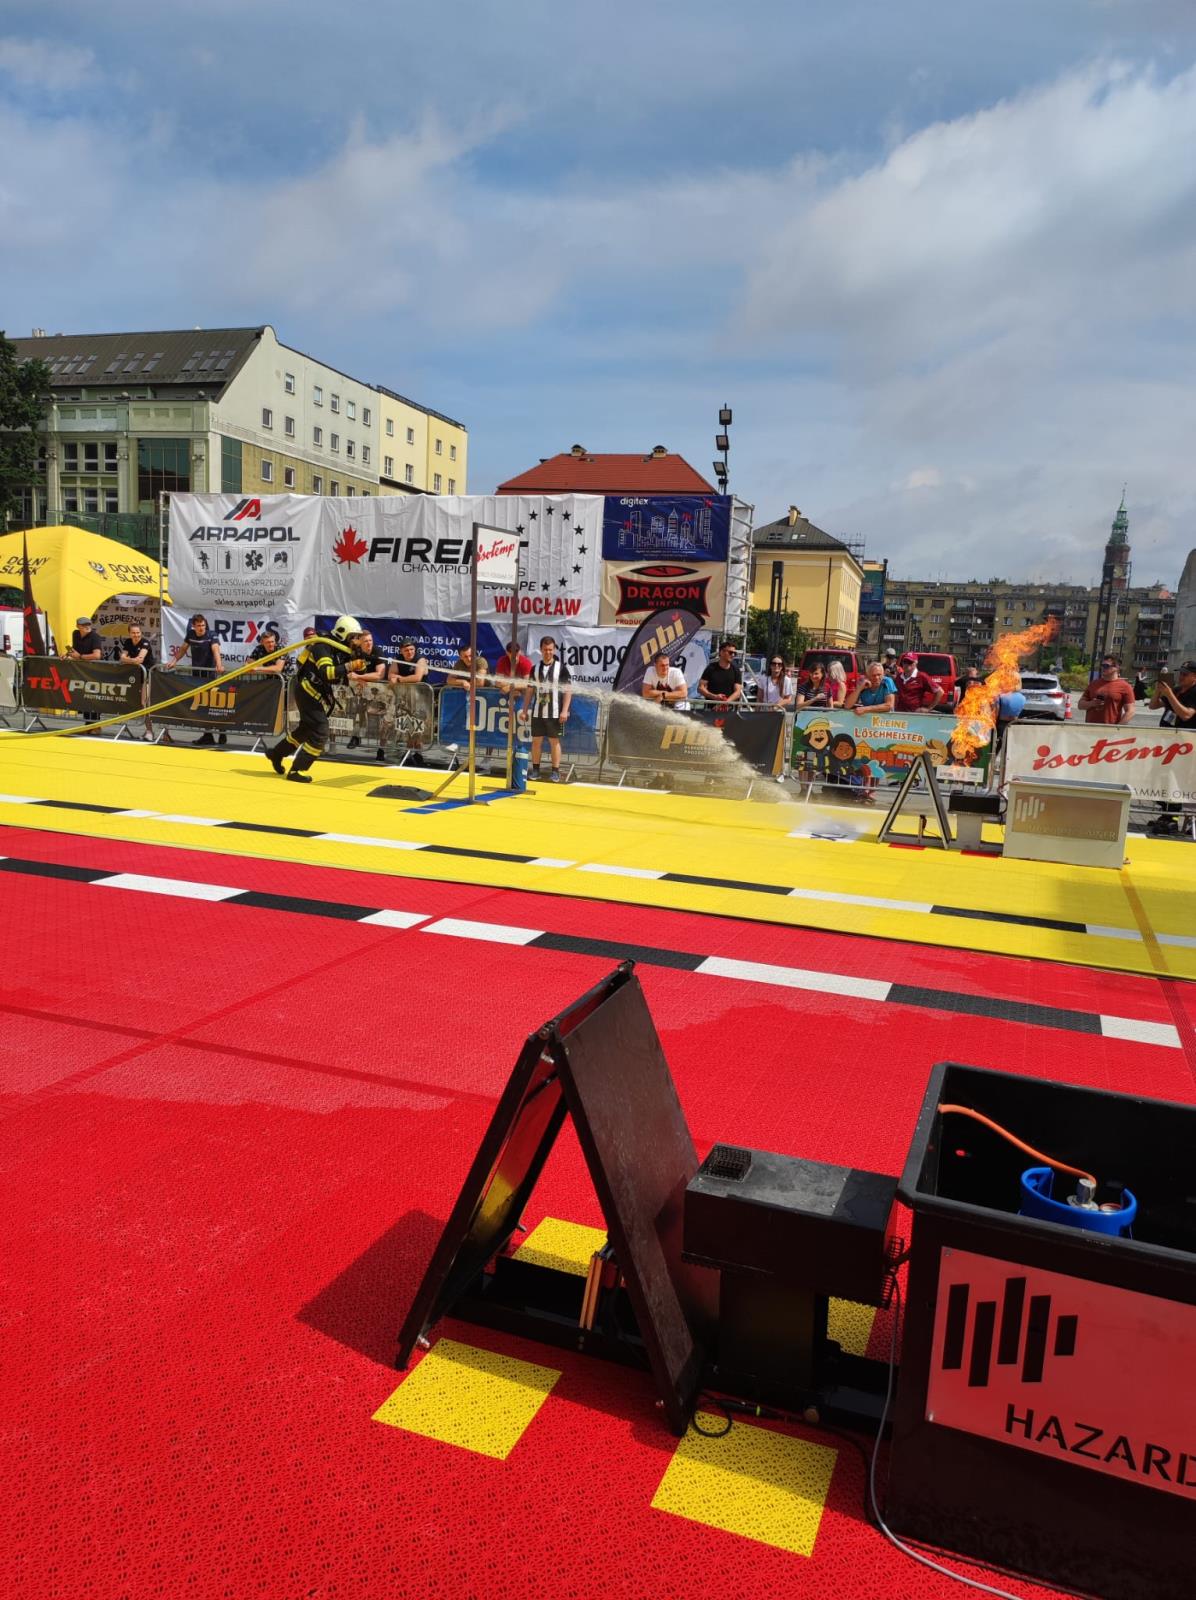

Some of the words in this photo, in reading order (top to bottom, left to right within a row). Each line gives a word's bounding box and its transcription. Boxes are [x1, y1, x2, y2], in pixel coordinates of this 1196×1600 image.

[620, 497, 649, 507] digitex
[189, 526, 300, 542] ARPAPOL
[368, 537, 528, 564] FIRE
[476, 538, 515, 563] isotemp
[108, 563, 151, 574] DOLNY
[401, 563, 526, 577] CHAMPIOS
[627, 586, 700, 599] DRAGON
[214, 599, 275, 608] sklep.arpapol.pl
[495, 596, 582, 616] WOCŁAW
[432, 637, 443, 645] 25
[446, 638, 460, 646] LAT
[641, 612, 684, 665] pbi
[417, 648, 482, 657] GOSPODAY
[27, 666, 131, 704] TEXPORT
[190, 686, 237, 711] pbi
[396, 714, 425, 734] HAIX
[466, 695, 532, 742] Dräg
[872, 716, 907, 729] KLEINE
[854, 728, 924, 742] LÖSCHMEISTER
[1033, 737, 1194, 770] isotemp
